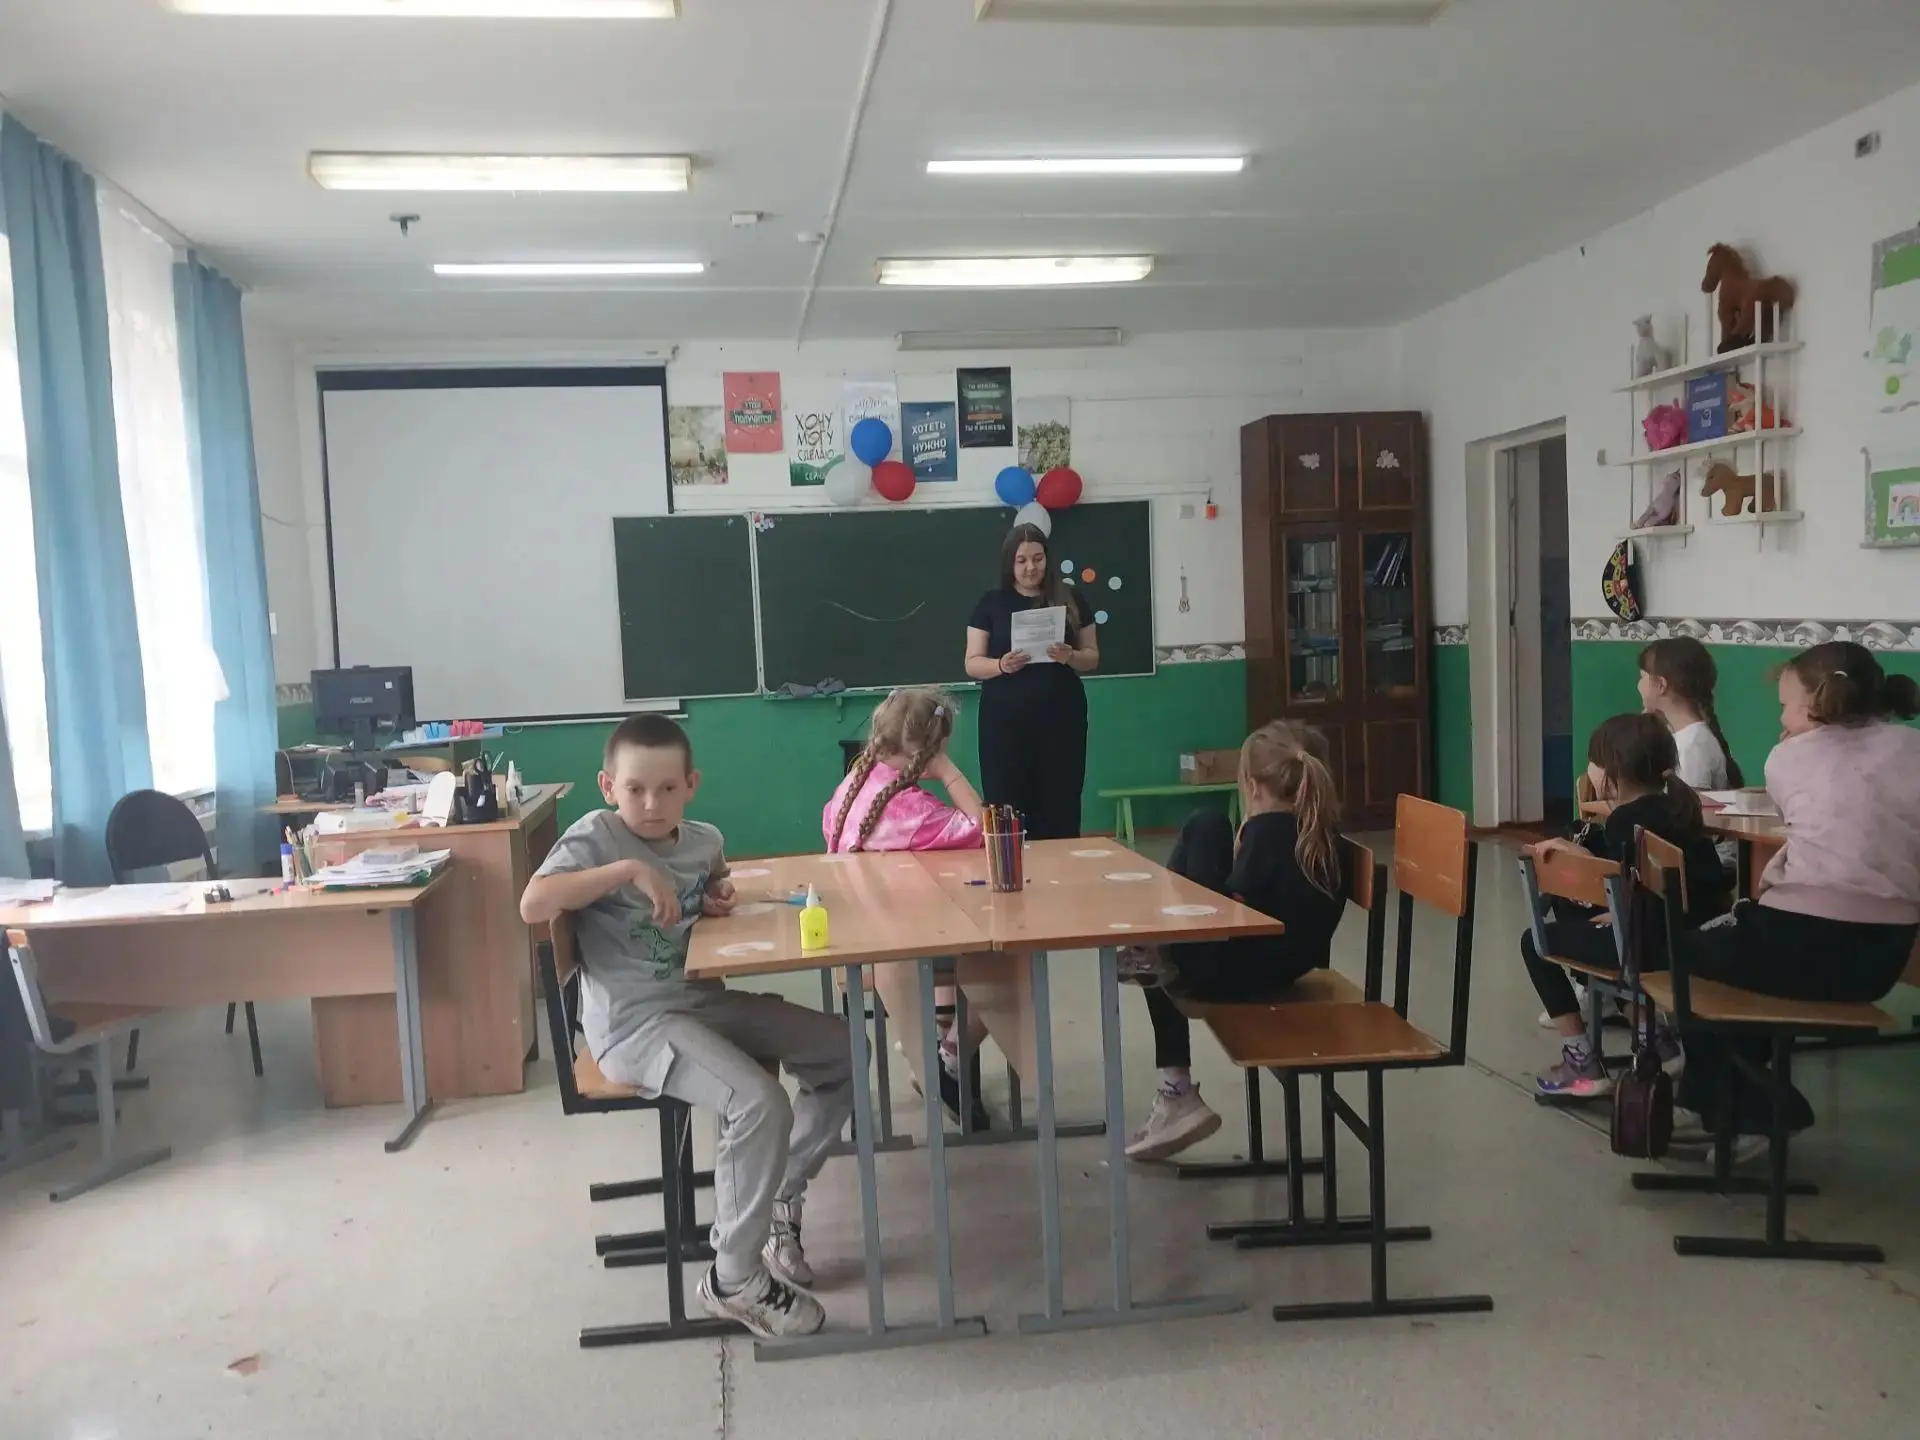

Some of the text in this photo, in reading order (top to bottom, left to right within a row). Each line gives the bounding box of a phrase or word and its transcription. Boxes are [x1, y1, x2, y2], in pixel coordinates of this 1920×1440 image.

[795, 412, 833, 432] ХОЧУ
[911, 420, 946, 436] ХОТЕТЬ
[797, 430, 834, 447] МОГУ
[912, 438, 947, 454] НУЖНО
[798, 448, 835, 461] СДЕЛАЮ
